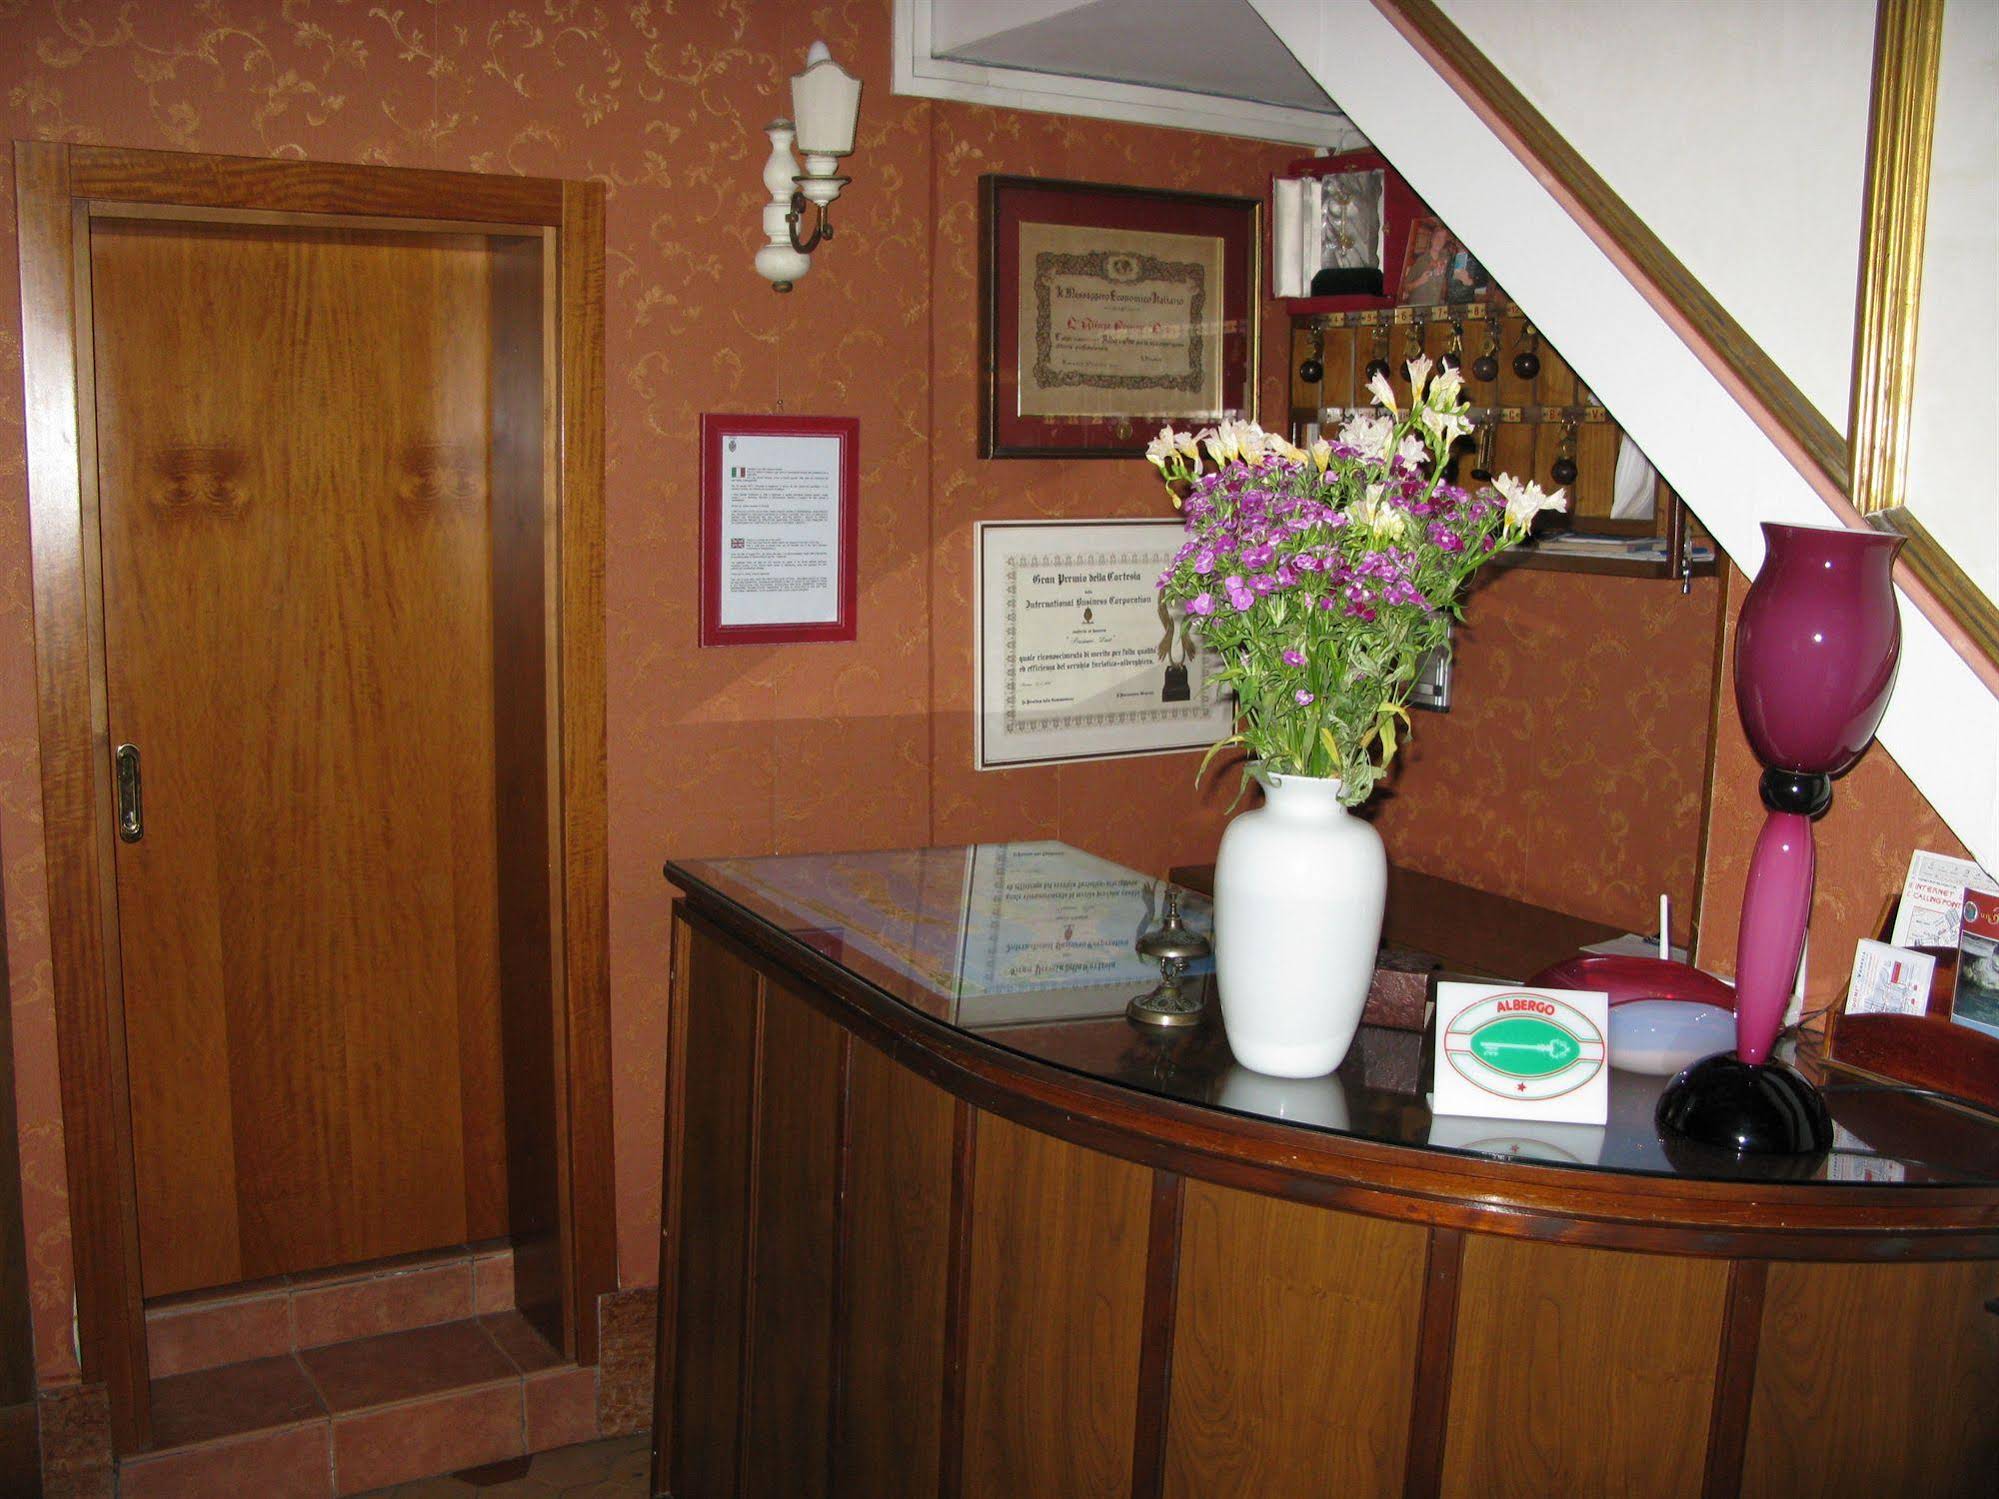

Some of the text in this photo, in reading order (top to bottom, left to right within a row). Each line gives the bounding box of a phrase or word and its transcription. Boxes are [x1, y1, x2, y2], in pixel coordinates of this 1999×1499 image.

[1032, 571, 1141, 586] Gran Premio della Cortesia
[1025, 596, 1151, 609] International Business Corporation
[1914, 882, 1955, 896] INTERNET
[1497, 999, 1555, 1016] ALBERGO
